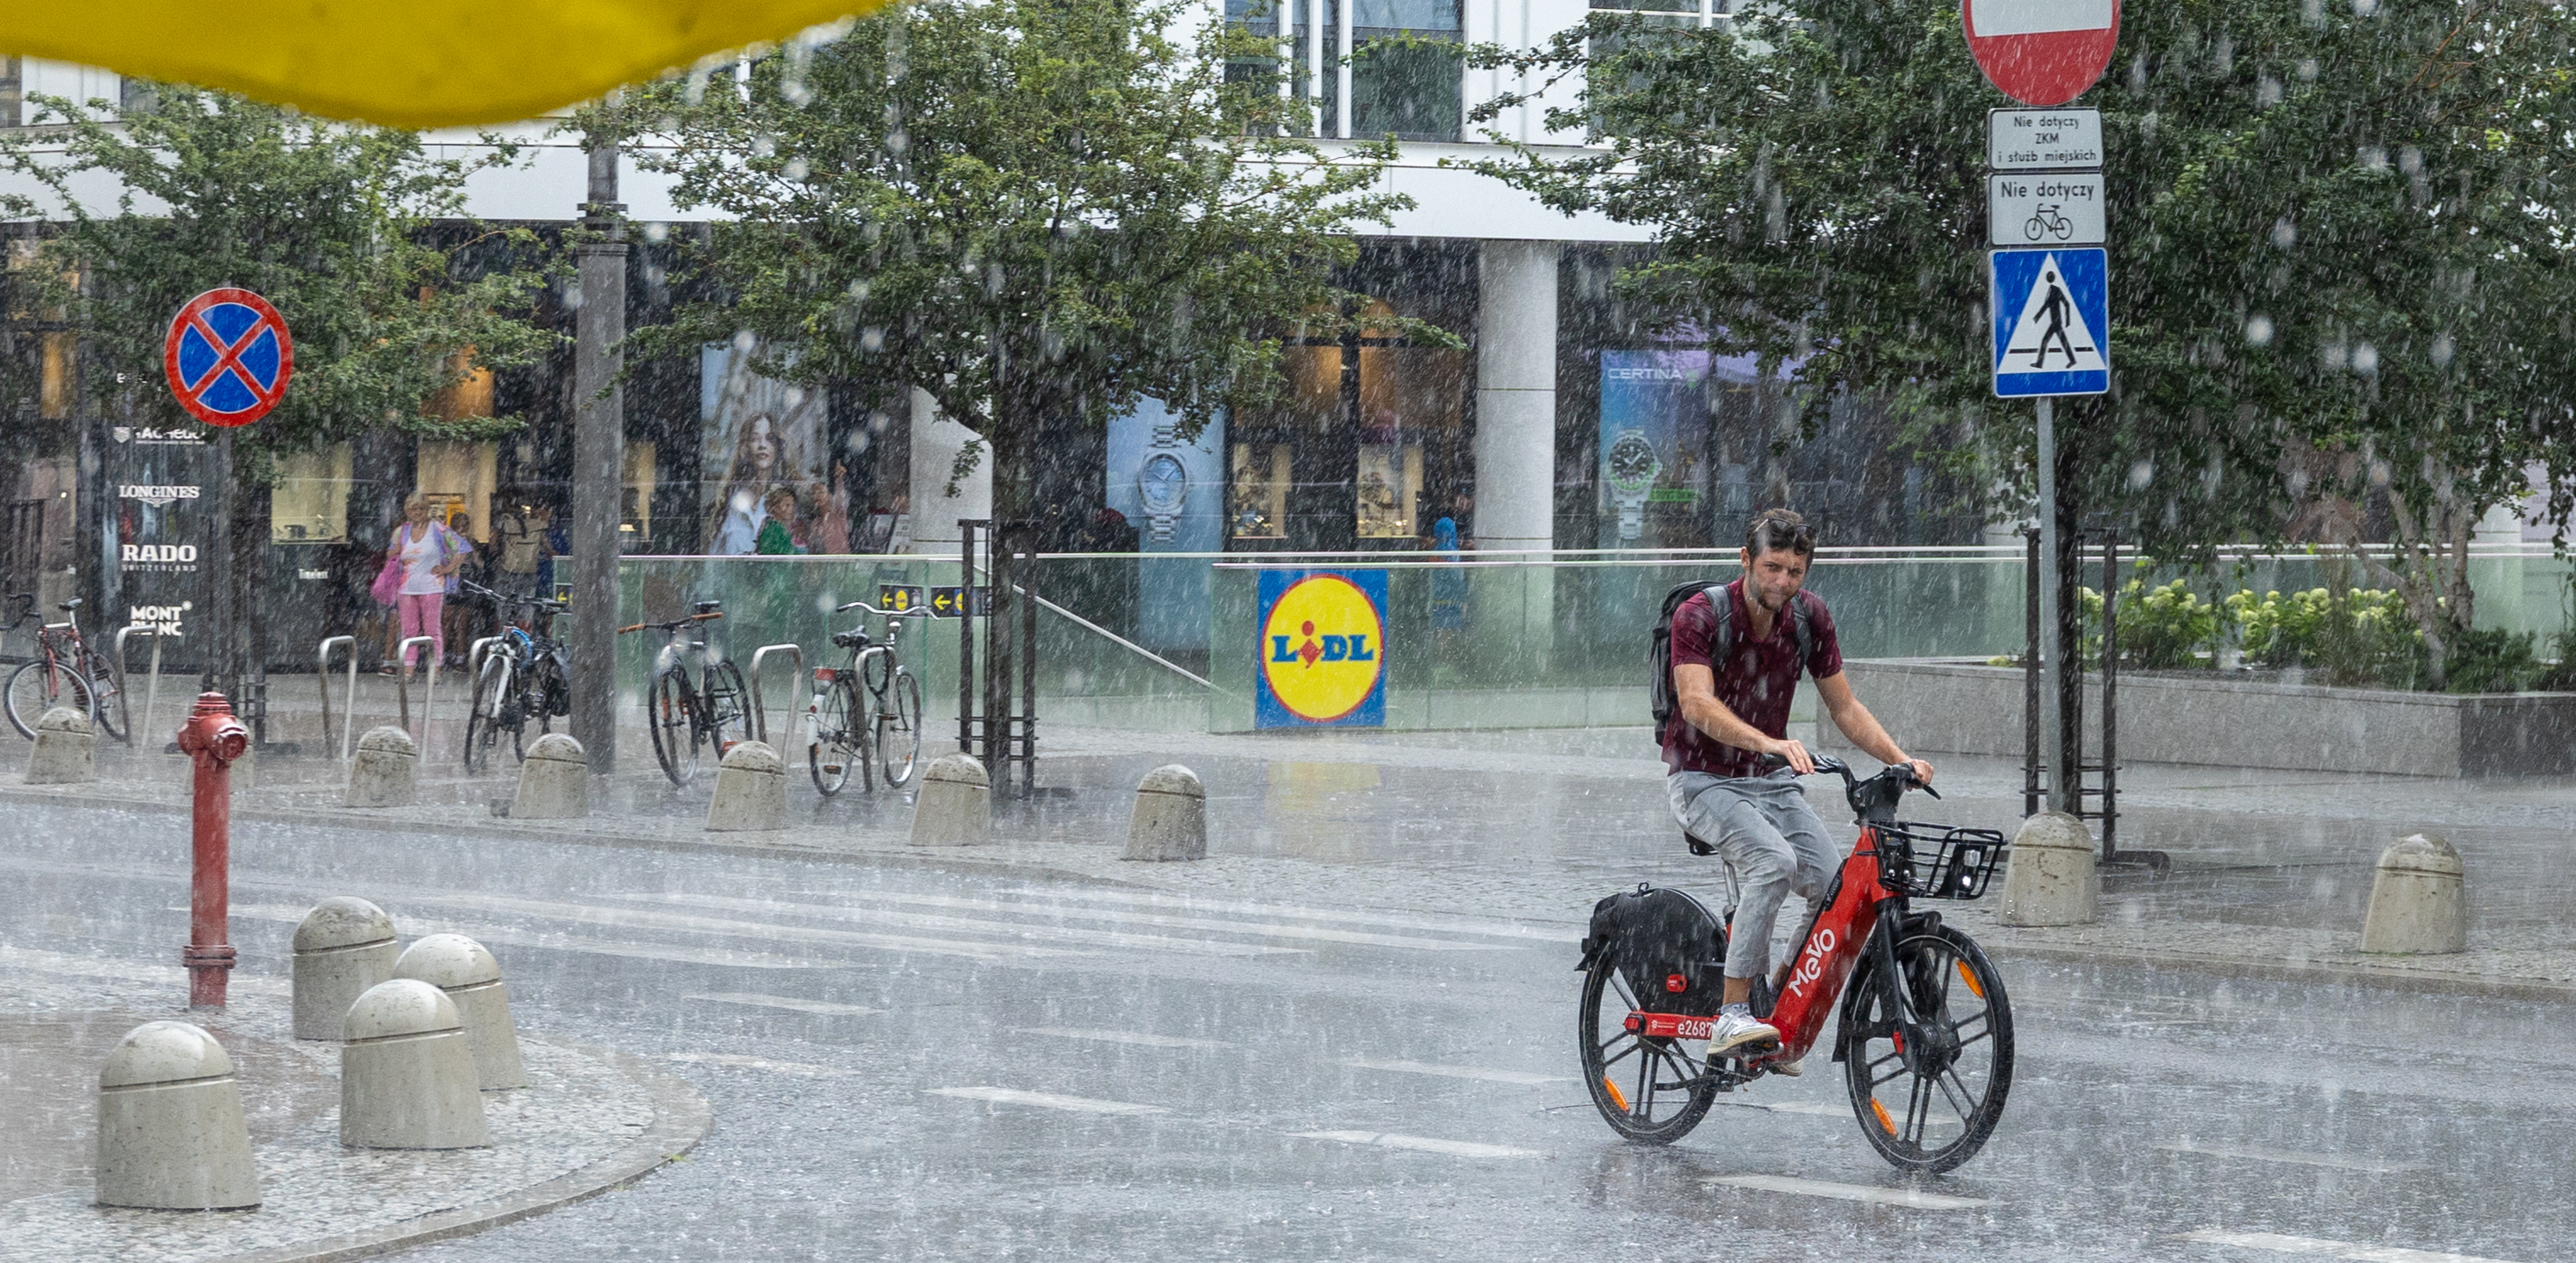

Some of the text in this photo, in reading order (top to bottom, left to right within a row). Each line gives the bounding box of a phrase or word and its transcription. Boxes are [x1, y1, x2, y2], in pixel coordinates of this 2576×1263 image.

[2014, 116, 2079, 129] Nie dotyczy
[2035, 133, 2059, 144] ZKM
[1998, 149, 2096, 164] i służb miejskich
[2001, 181, 2094, 201] Nie dotyczy
[1608, 368, 1683, 380] CERTINA
[118, 485, 201, 498] LONGINES
[122, 544, 197, 562] RADO
[131, 605, 182, 621] MONT
